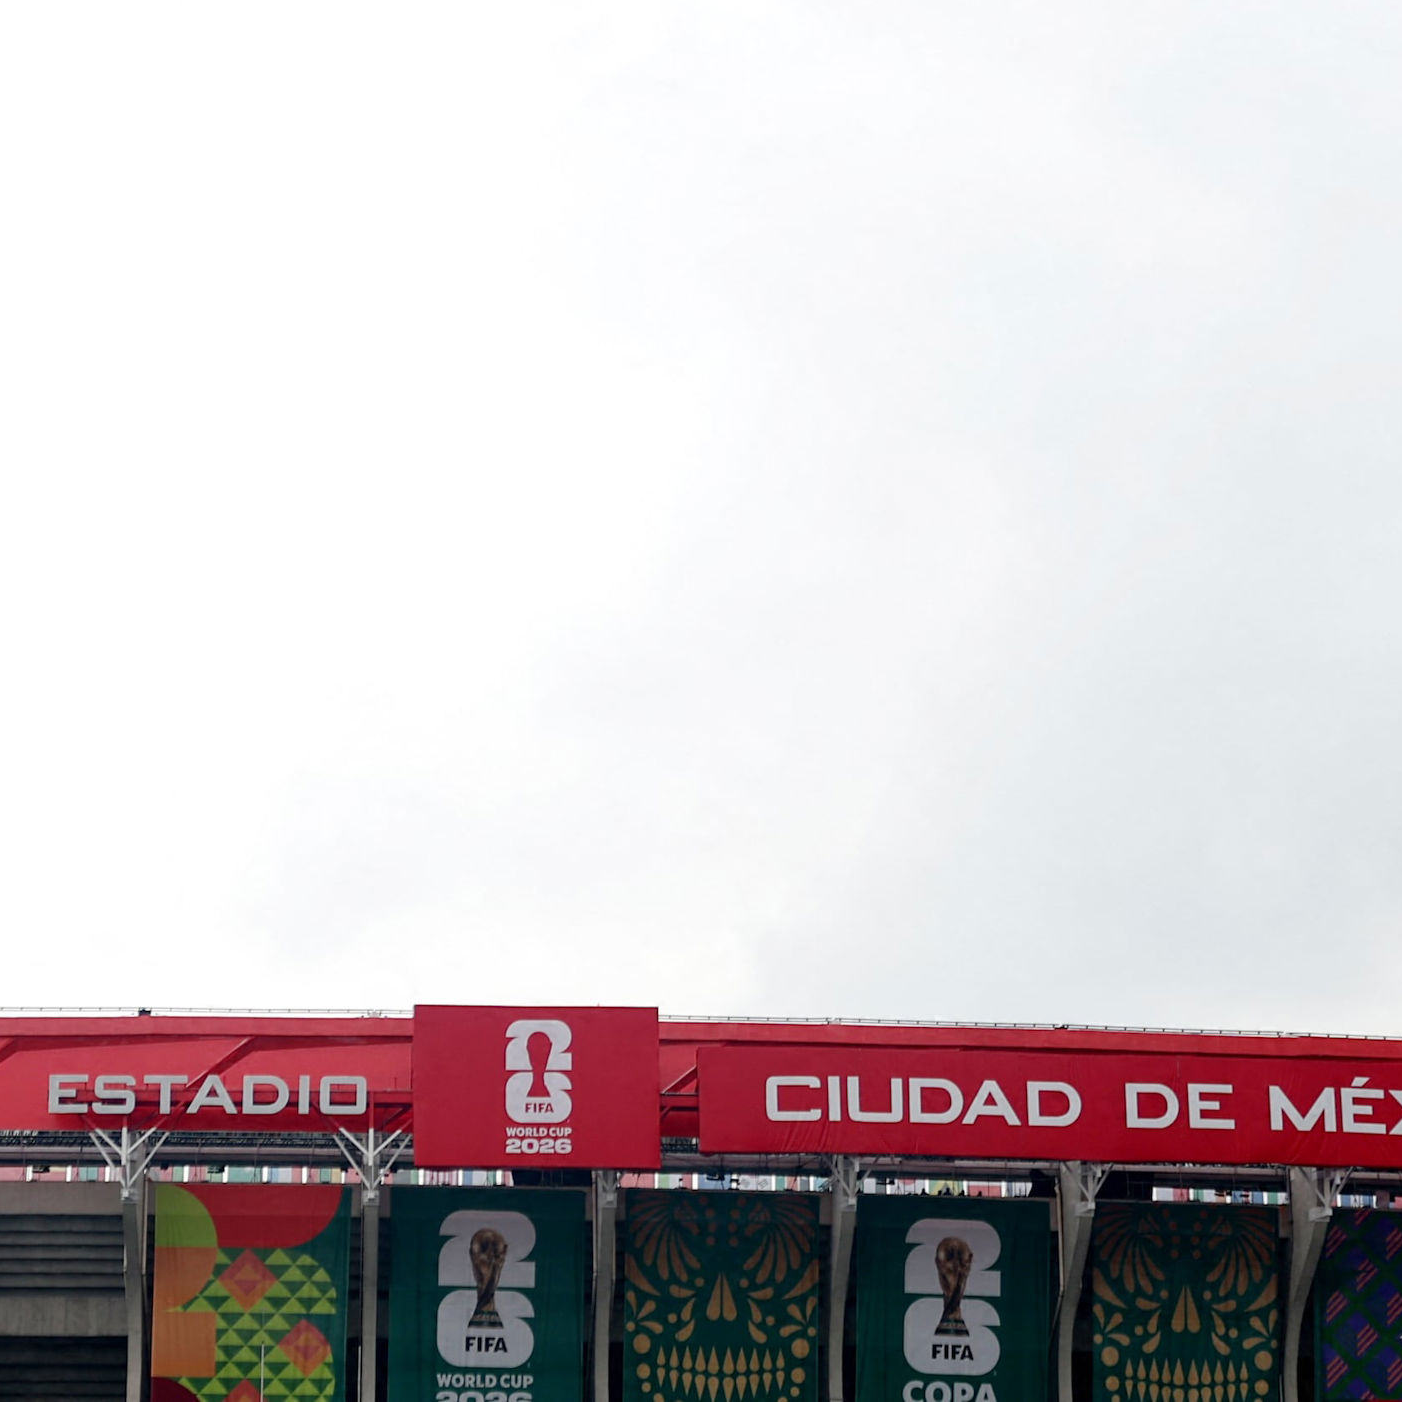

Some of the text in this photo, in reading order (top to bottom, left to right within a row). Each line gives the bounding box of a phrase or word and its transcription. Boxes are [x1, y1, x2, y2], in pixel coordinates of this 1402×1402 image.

[48, 1074, 367, 1115] ESTADIO
[765, 1075, 1082, 1127] CIUDAD
[1124, 1082, 1236, 1130] DE
[524, 1102, 554, 1113] FIFA
[506, 1127, 572, 1137] WORLD CUP
[505, 1138, 572, 1154] 2026
[465, 1336, 508, 1352] FIFA
[931, 1344, 974, 1361] FIFA
[436, 1373, 534, 1389] WORLD CUP
[902, 1380, 998, 1402] COPA
